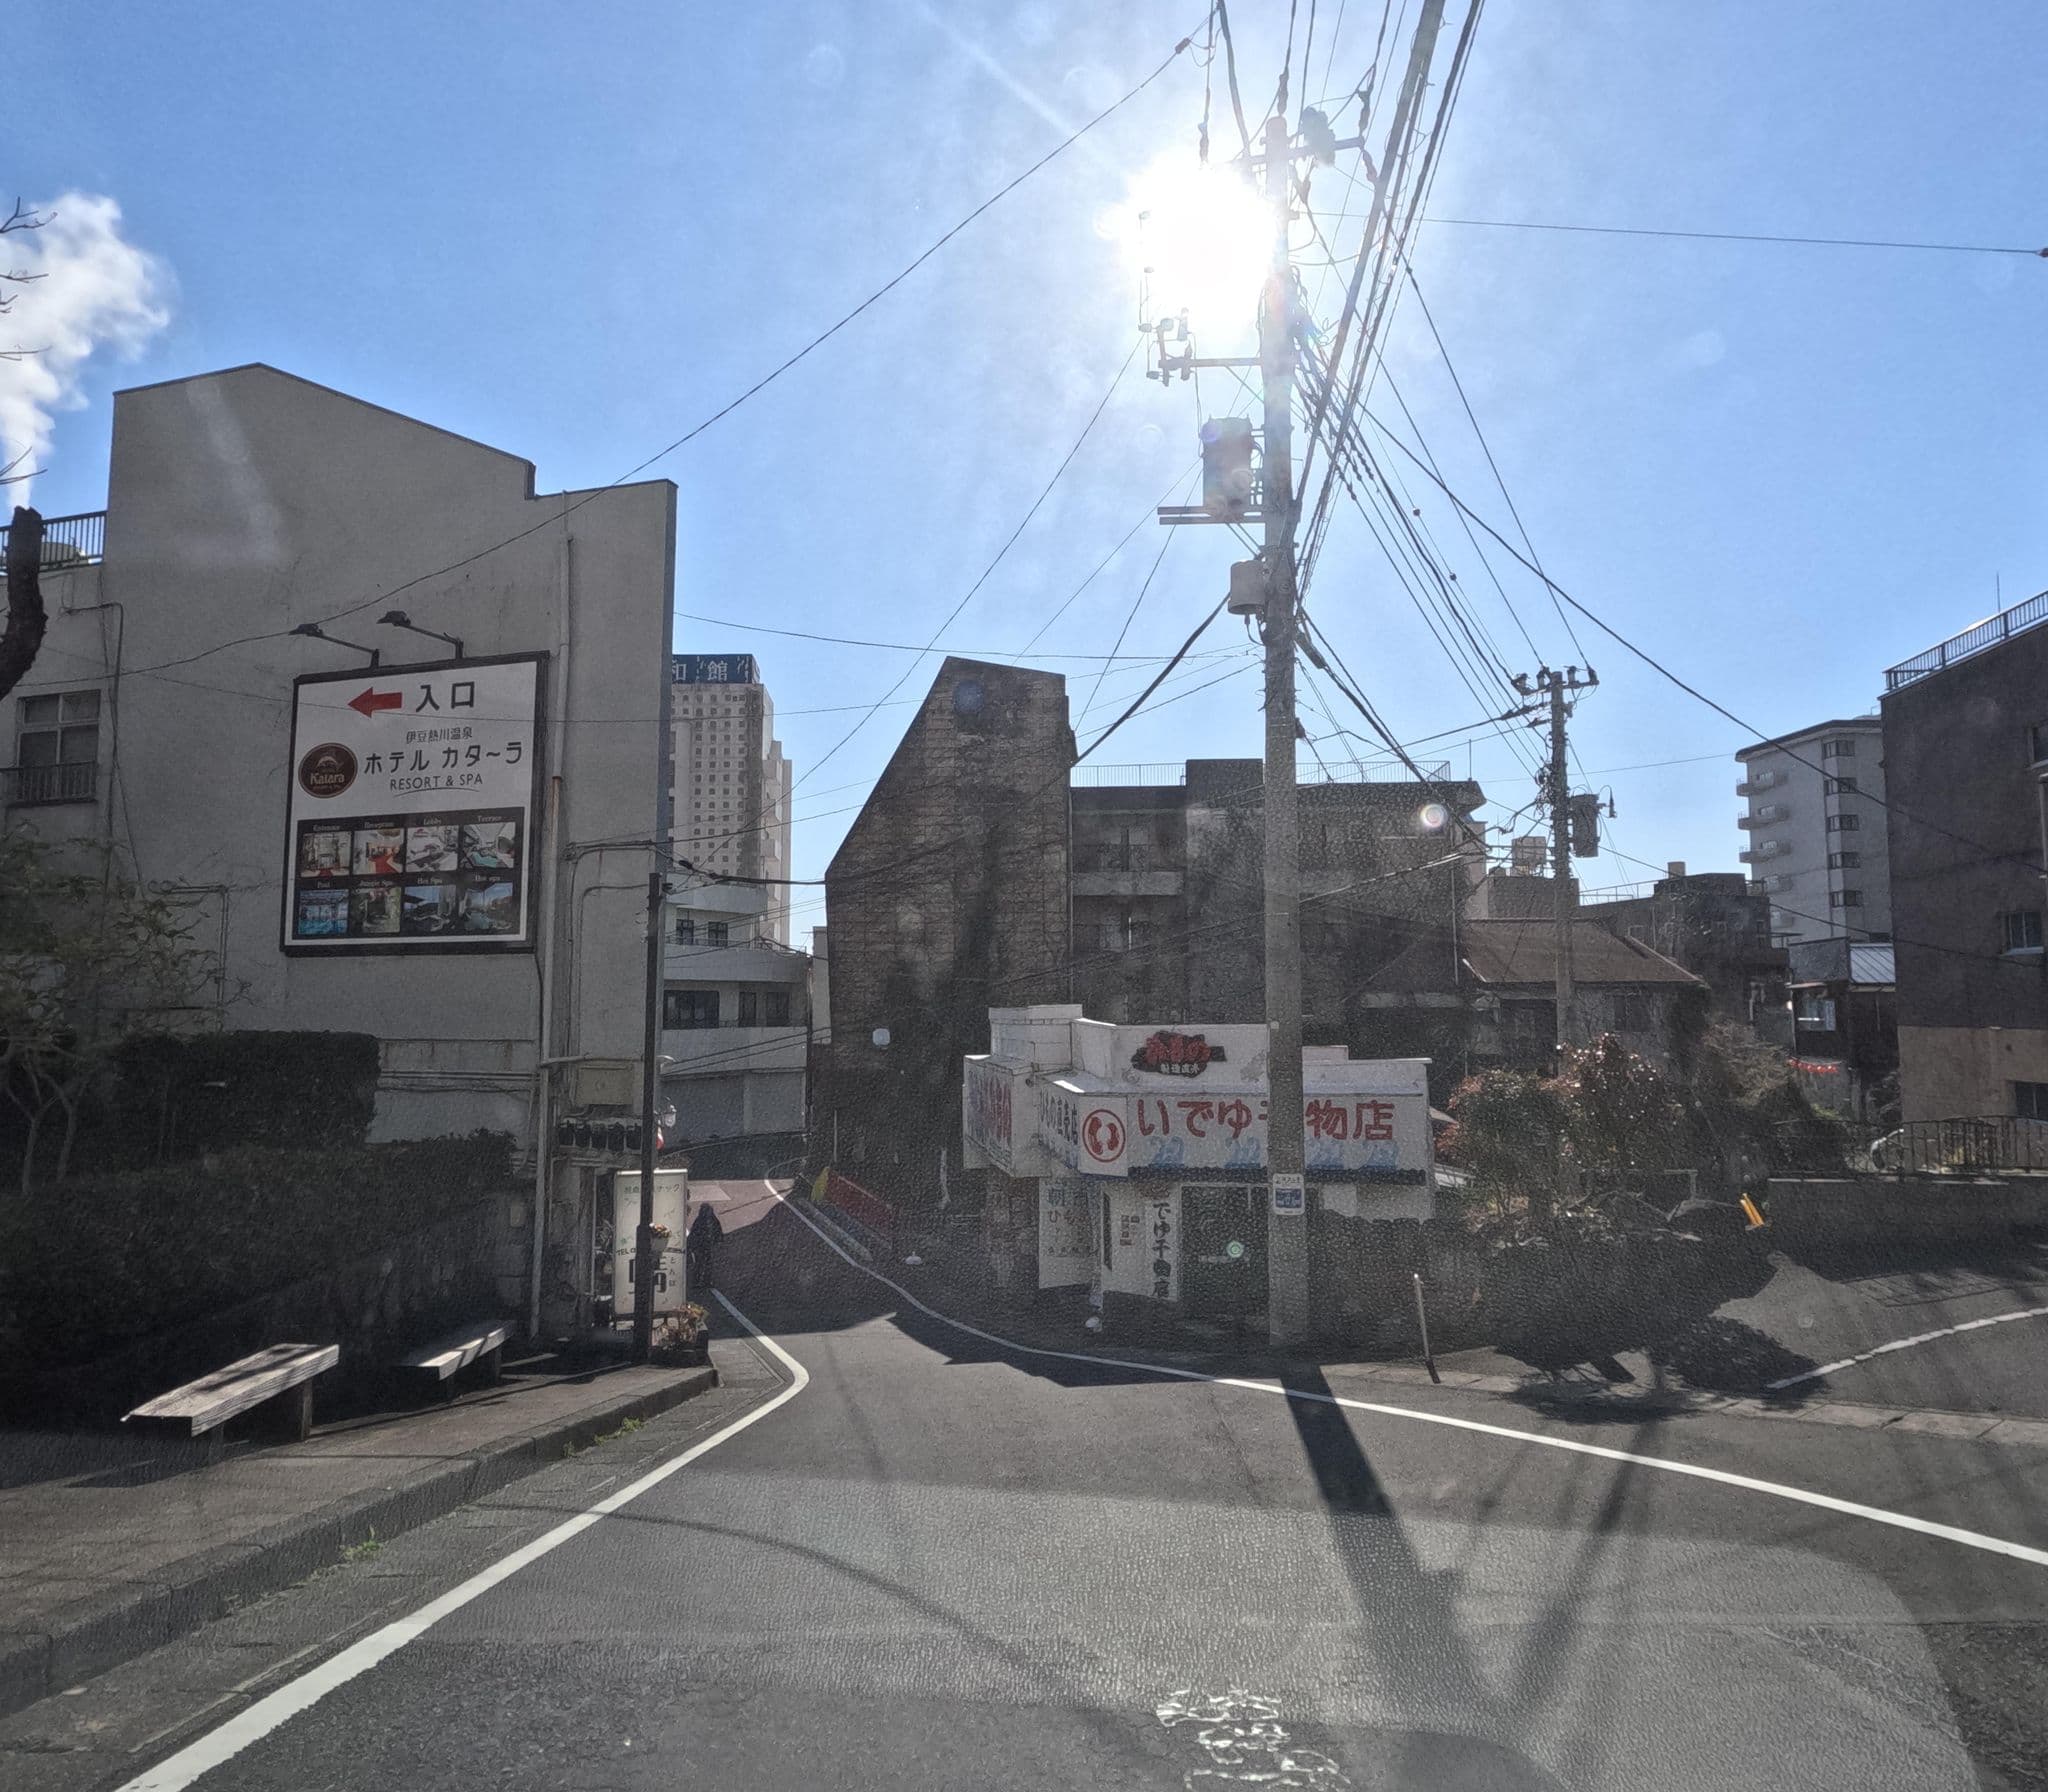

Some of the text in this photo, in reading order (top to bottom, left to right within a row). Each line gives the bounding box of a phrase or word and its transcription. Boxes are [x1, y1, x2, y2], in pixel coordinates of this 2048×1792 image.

[415, 681, 475, 713] 入口
[406, 727, 473, 744] 伊豆熱川温泉
[310, 771, 345, 786] Katara
[390, 773, 483, 791] RESORT & SPA
[1137, 1099, 1395, 1140] いでゆ物店
[616, 1247, 630, 1256] TEL
